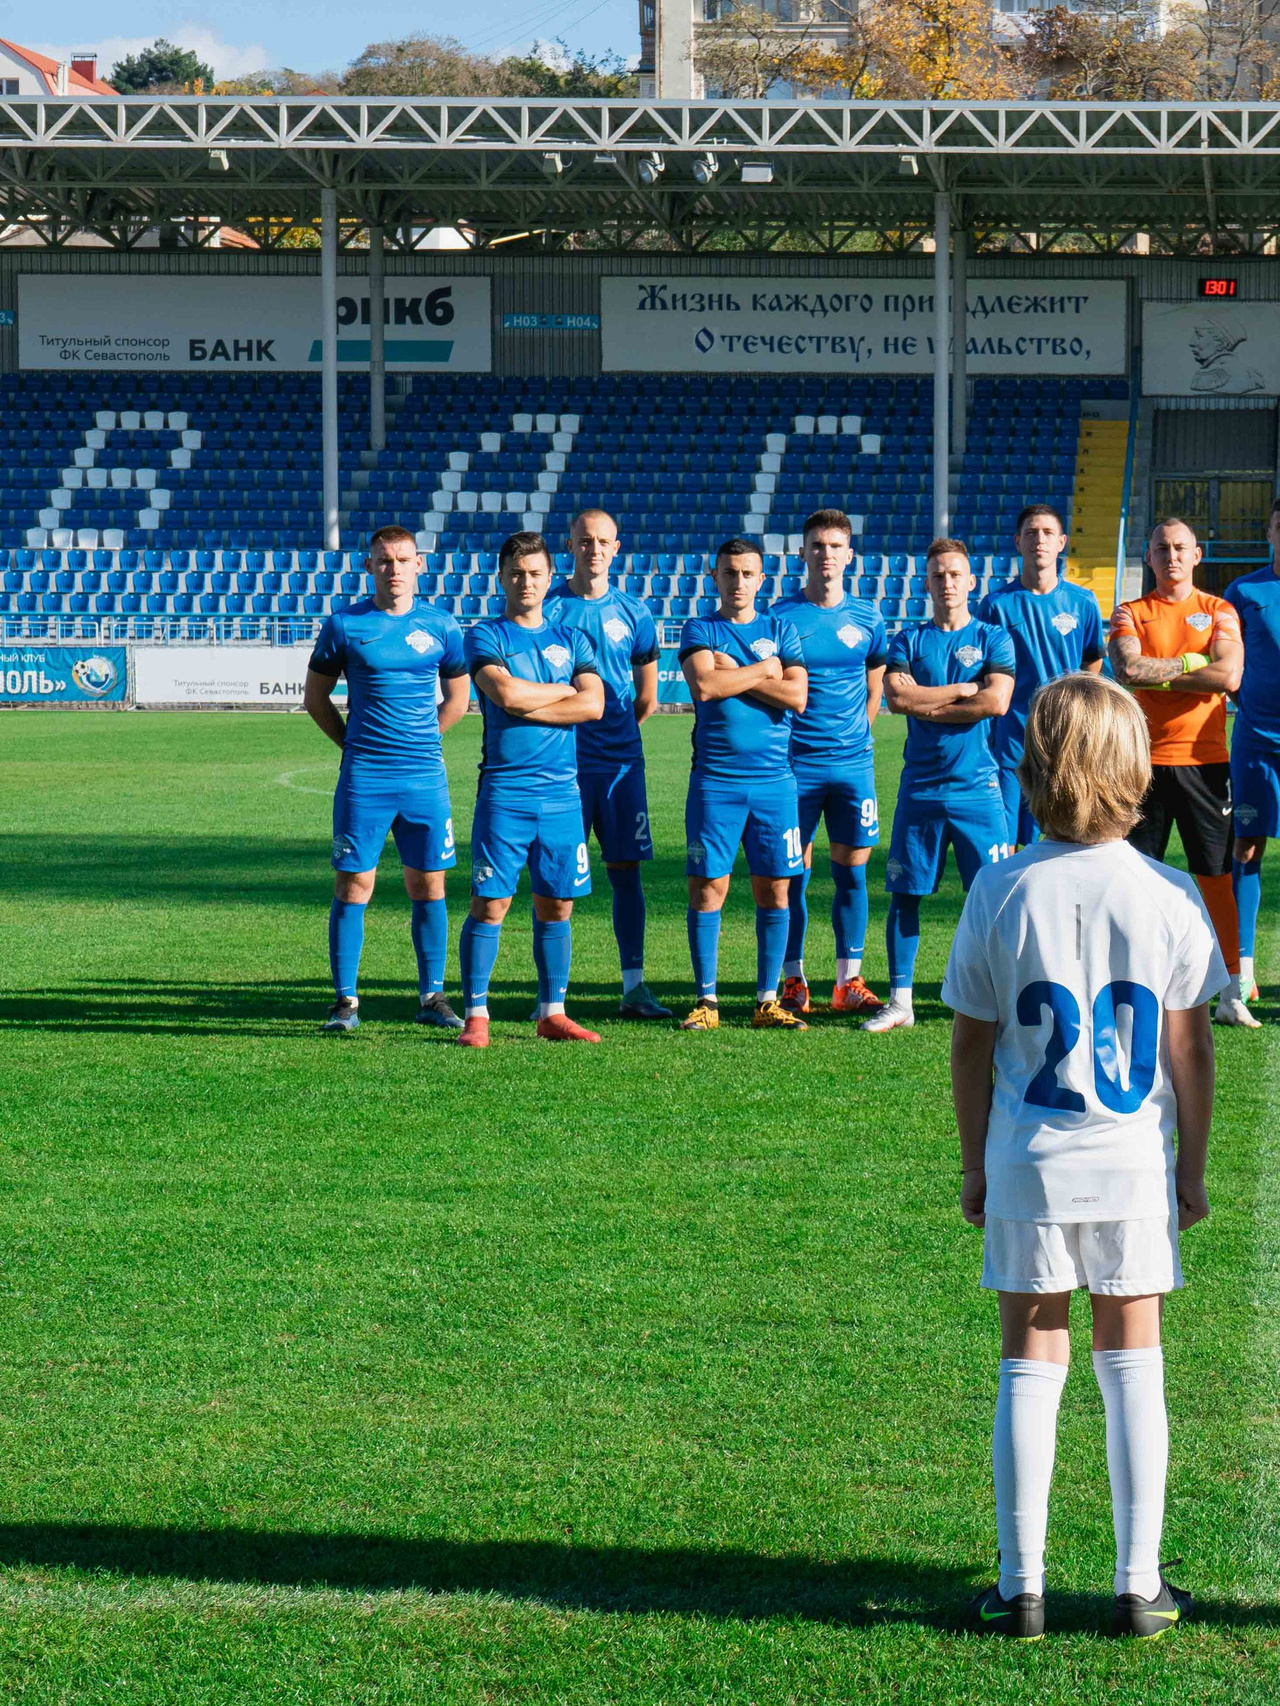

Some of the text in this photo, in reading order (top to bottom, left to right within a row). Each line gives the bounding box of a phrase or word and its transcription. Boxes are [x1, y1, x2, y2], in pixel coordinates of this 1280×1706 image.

[636, 285, 1089, 321] Жизнь каждого придлежит
[39, 335, 170, 349] Титульный спонсор
[189, 339, 276, 362] БАНК
[883, 336, 917, 355] не
[60, 350, 170, 362] ФК Севастополь
[21, 653, 46, 663] КЛУБ
[782, 827, 802, 859] 10
[576, 843, 589, 874] 9
[1016, 980, 1159, 1115] 20
